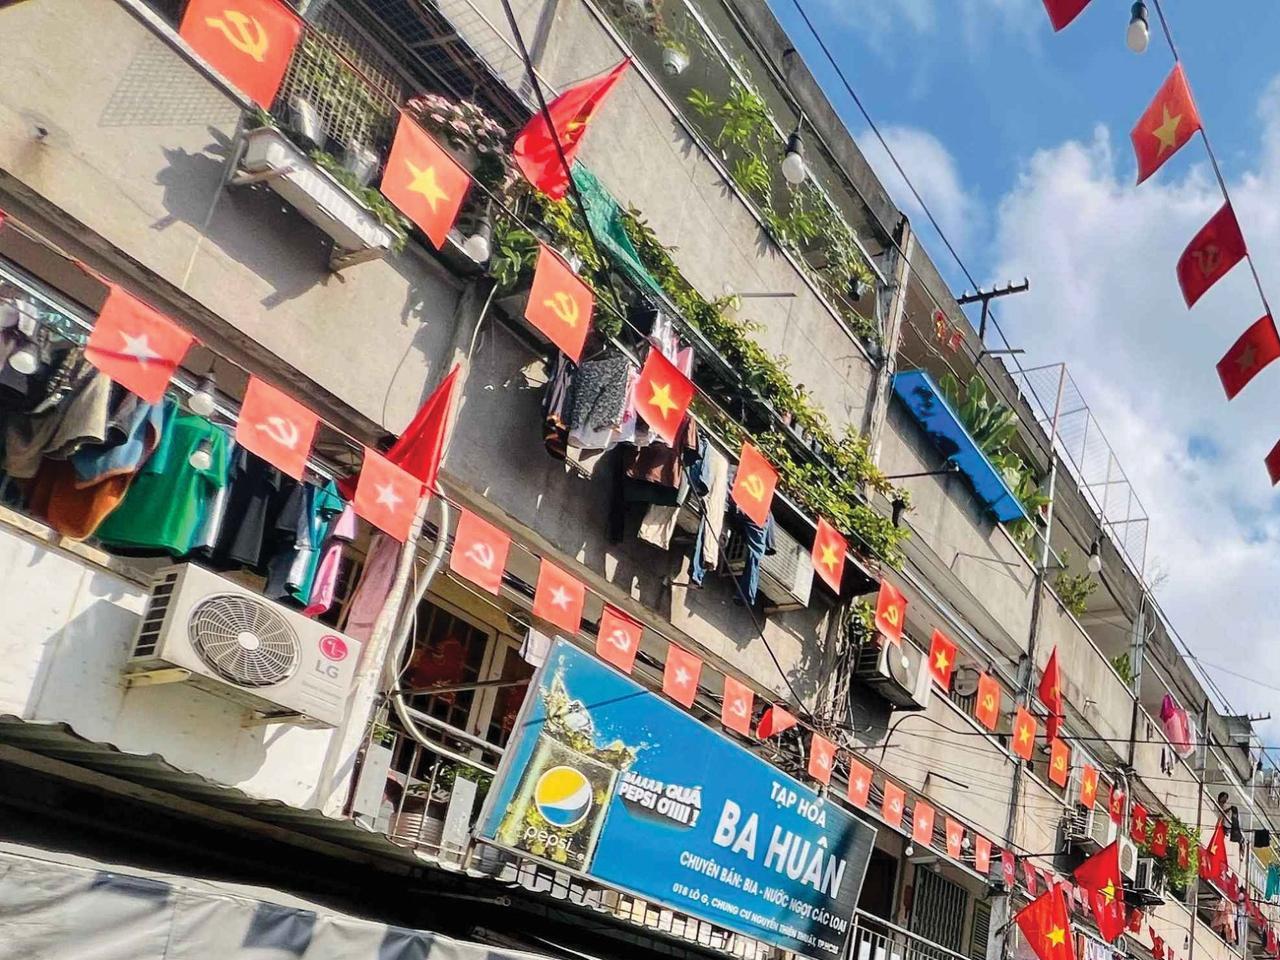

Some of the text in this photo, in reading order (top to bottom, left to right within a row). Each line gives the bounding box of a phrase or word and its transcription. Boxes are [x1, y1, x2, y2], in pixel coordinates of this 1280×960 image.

[315, 659, 339, 679] LG
[618, 782, 658, 810] PEPSI
[770, 781, 798, 809] TẠP
[523, 824, 574, 852] pepsi
[713, 799, 847, 899] BA HUÂN
[680, 851, 721, 879] CHUYÊN
[720, 865, 743, 889] BÁN:
[742, 877, 759, 896] BIA
[764, 884, 790, 909] NƯỚC
[789, 897, 813, 921] NGỌT
[812, 905, 830, 925] CÁC
[829, 917, 848, 936] LOẠI
[688, 886, 700, 901] LÔ
[711, 897, 740, 917] CHUNG
[740, 906, 752, 920] CƯ
